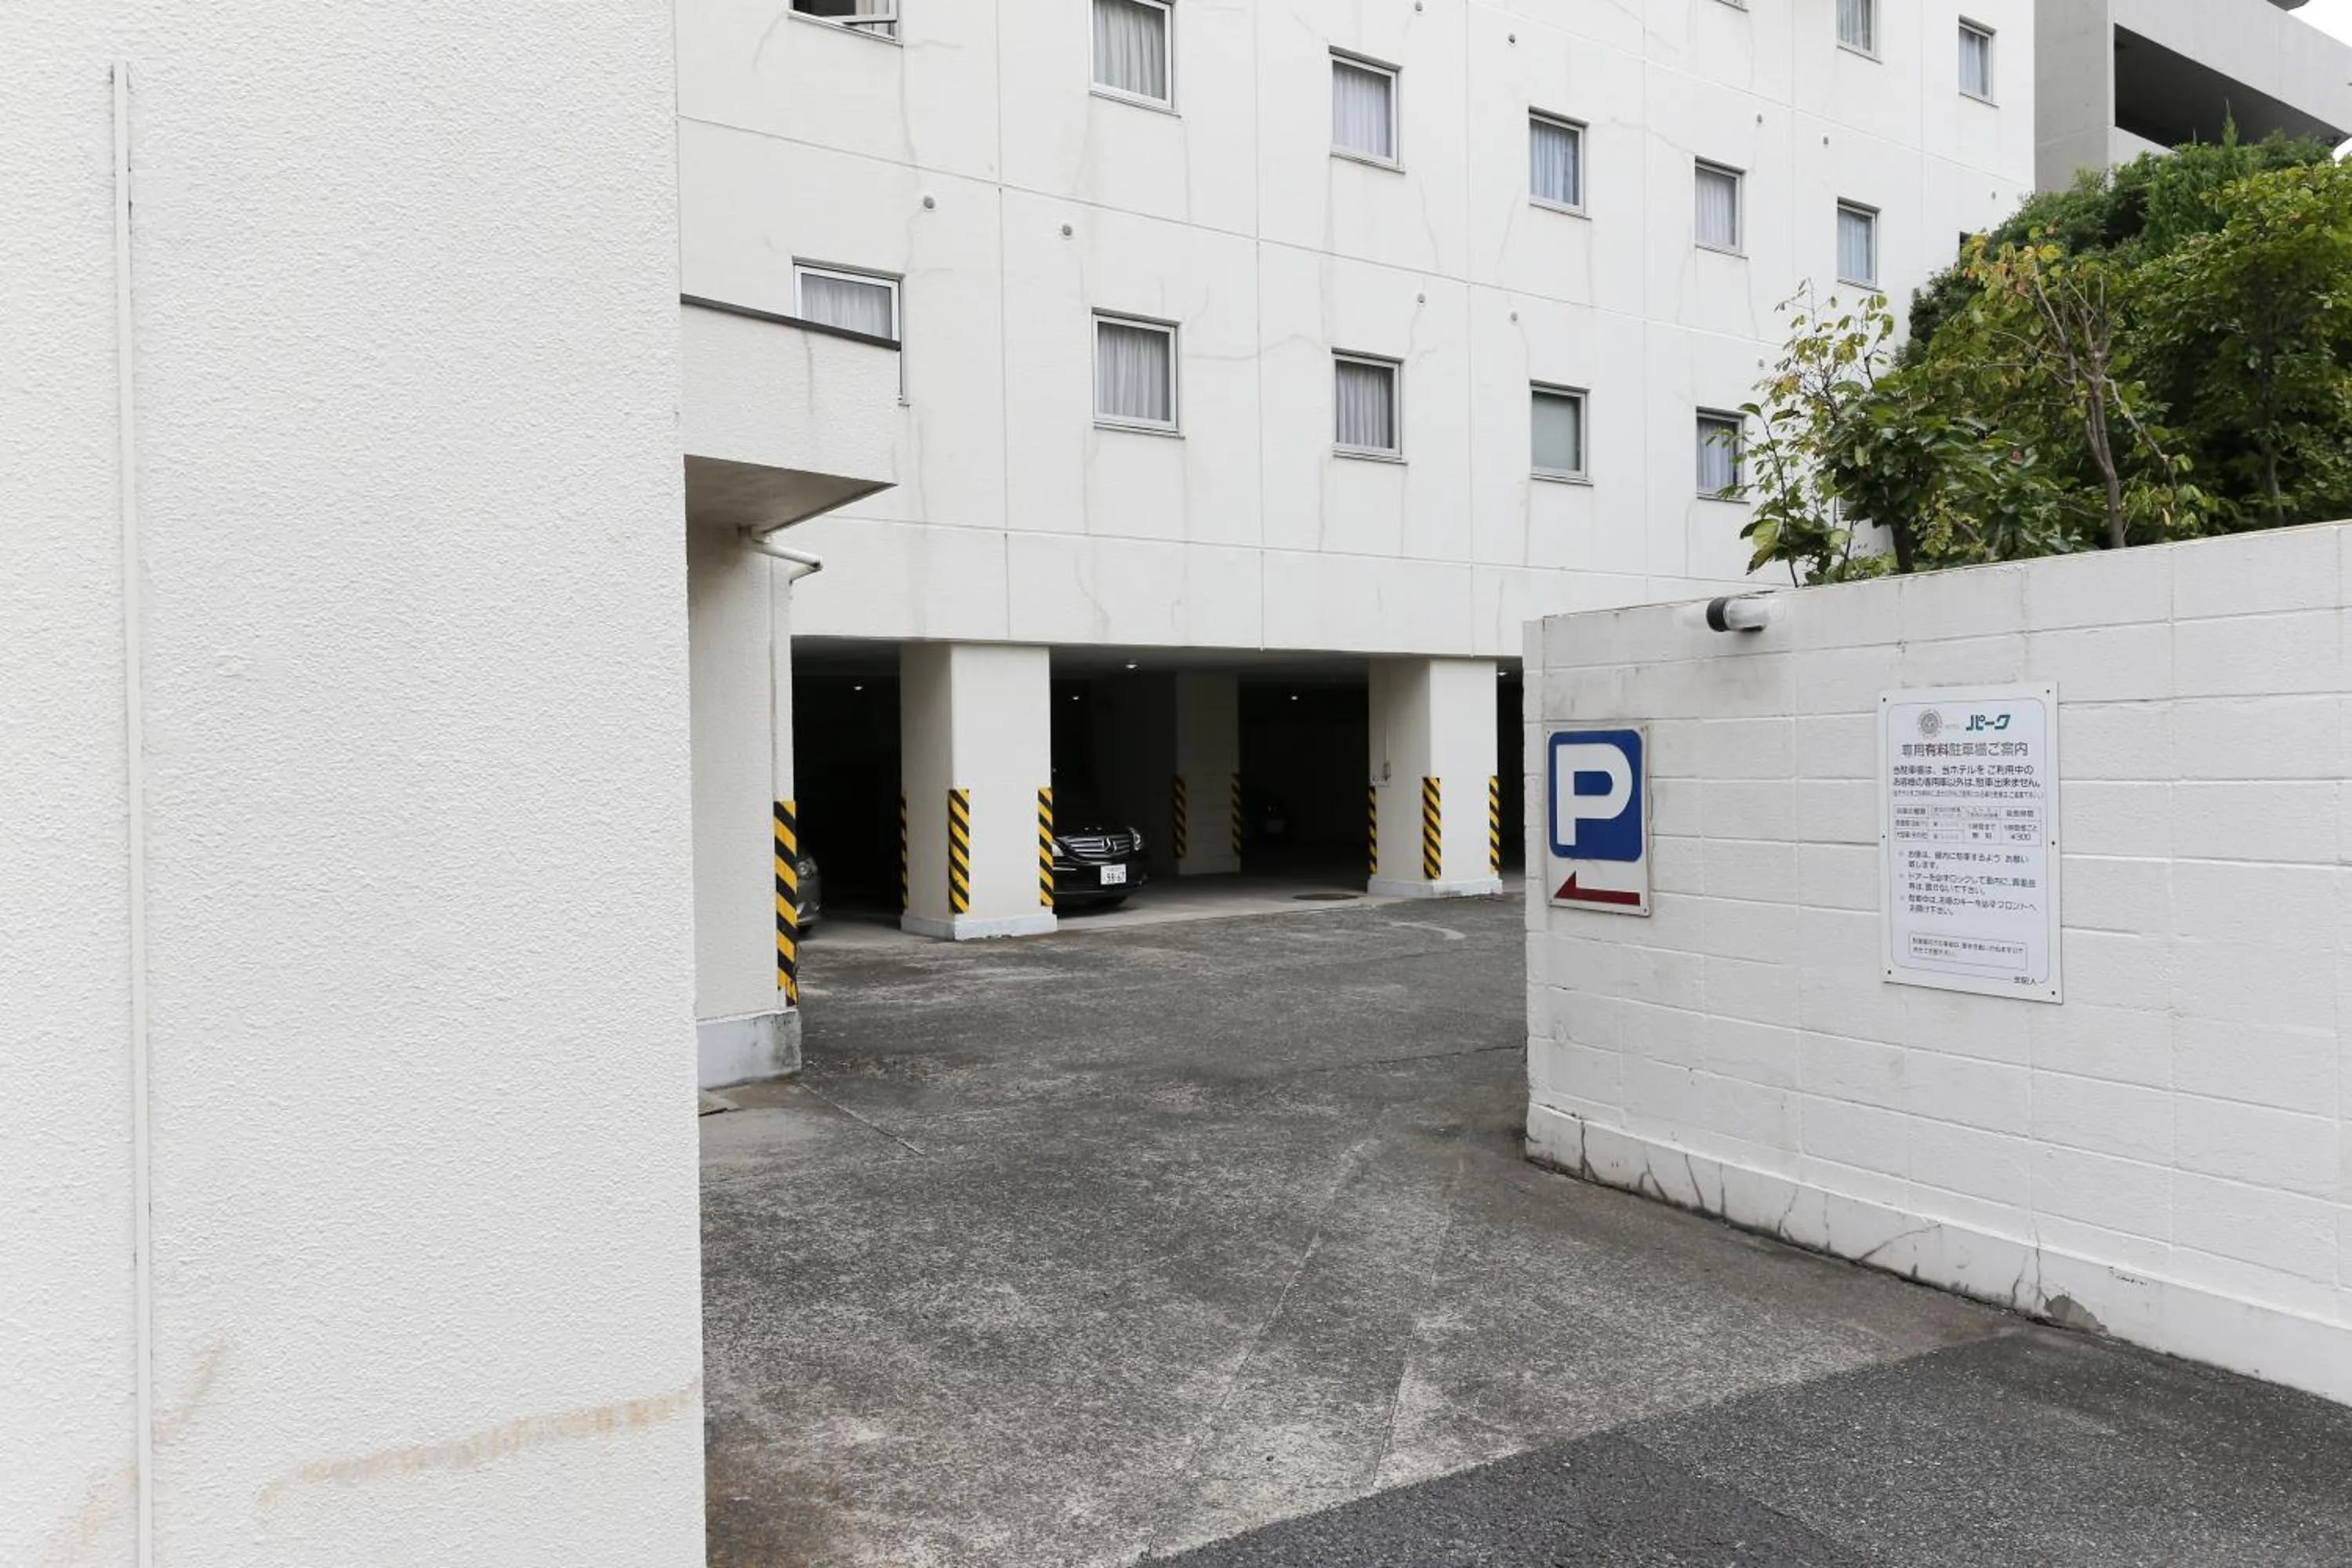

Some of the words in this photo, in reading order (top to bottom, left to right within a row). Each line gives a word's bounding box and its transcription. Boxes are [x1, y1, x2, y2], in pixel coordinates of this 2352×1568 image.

[1965, 714, 2011, 731] パーク
[1556, 743, 1633, 846] P
